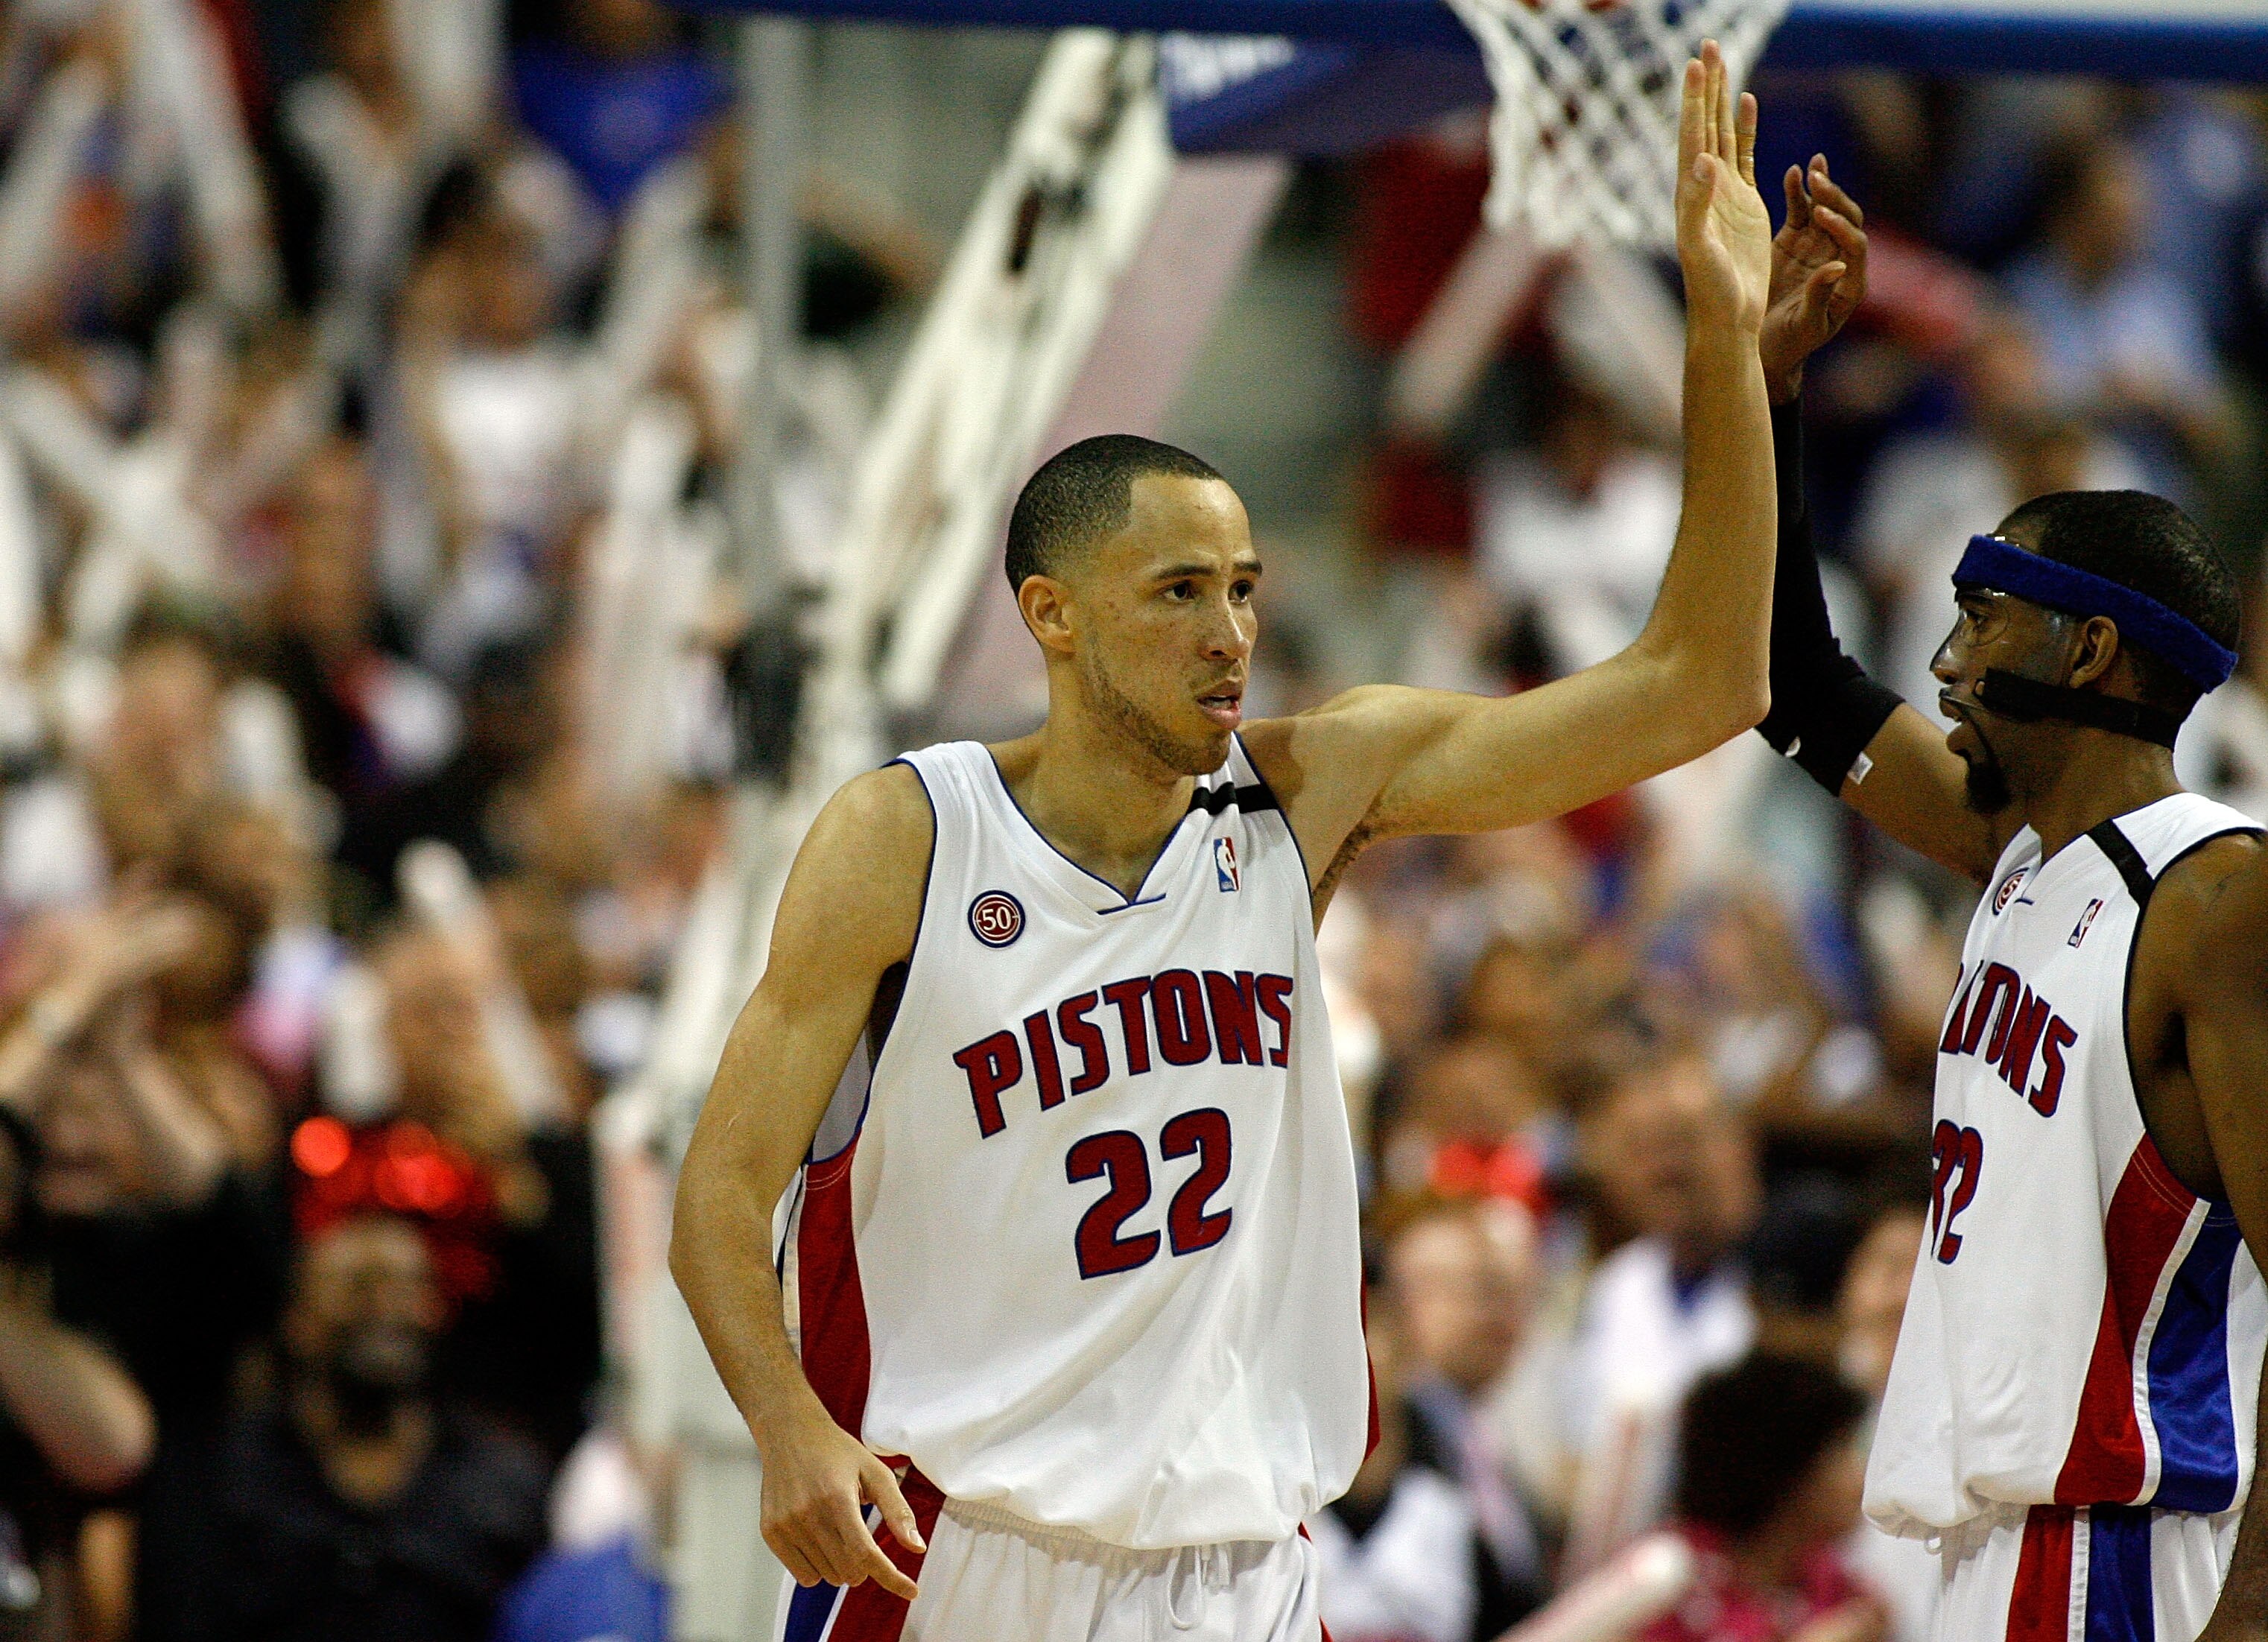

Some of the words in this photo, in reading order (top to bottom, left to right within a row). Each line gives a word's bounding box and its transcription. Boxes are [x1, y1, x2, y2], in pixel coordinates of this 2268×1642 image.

[982, 906, 1012, 931] 50
[953, 969, 1293, 1139] PISTONS
[1939, 962, 2079, 1118] TONS
[1065, 1107, 1232, 1280] 22
[1931, 1119, 1983, 1264] 32
